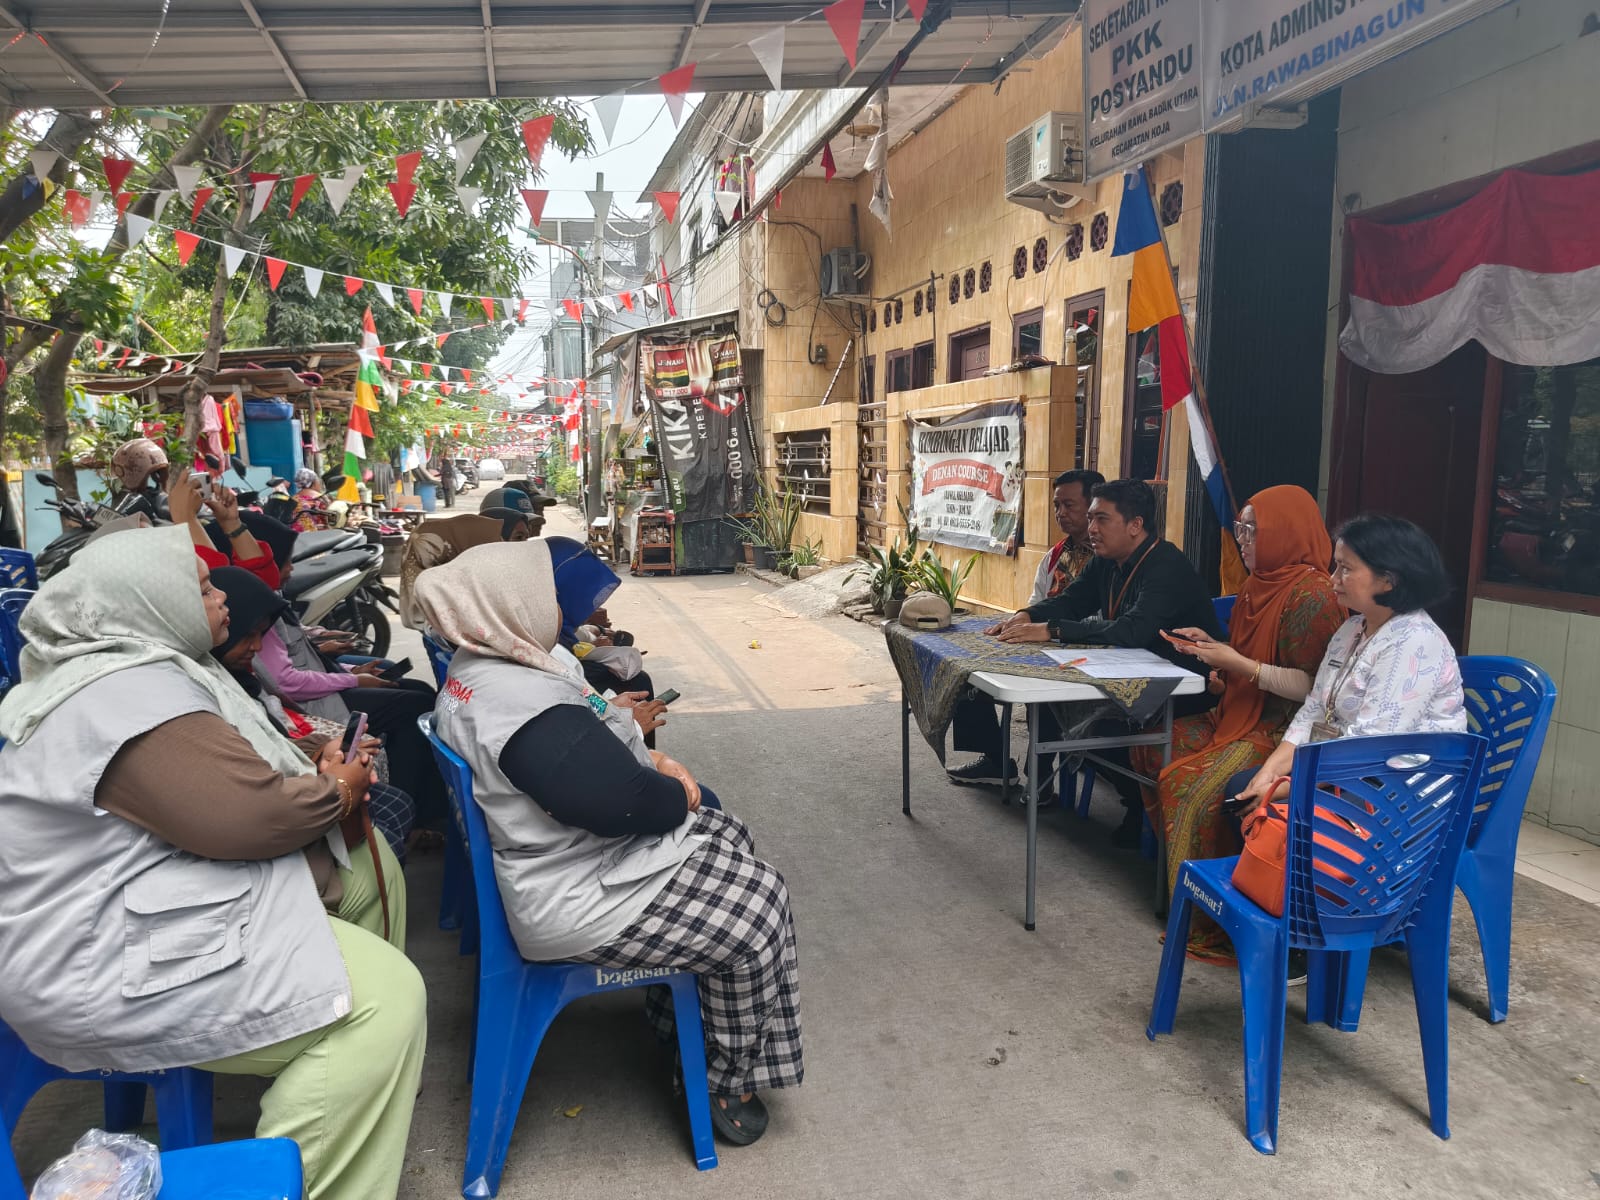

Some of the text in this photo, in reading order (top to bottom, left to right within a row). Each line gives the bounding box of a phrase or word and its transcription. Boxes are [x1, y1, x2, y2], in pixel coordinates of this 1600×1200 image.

[1112, 20, 1163, 75] PKK
[1220, 0, 1362, 78] KOTA ADMINIS
[1090, 44, 1193, 122] POSYANDU
[1089, 86, 1198, 149] KELURAHAN RAWA BADAK UTARA
[1111, 121, 1170, 158] KECAMATAN KOJA
[968, 425, 1010, 456] BELAJAR
[672, 478, 682, 505] BARU
[959, 463, 989, 484] COURSE
[1183, 871, 1223, 916] bogasari
